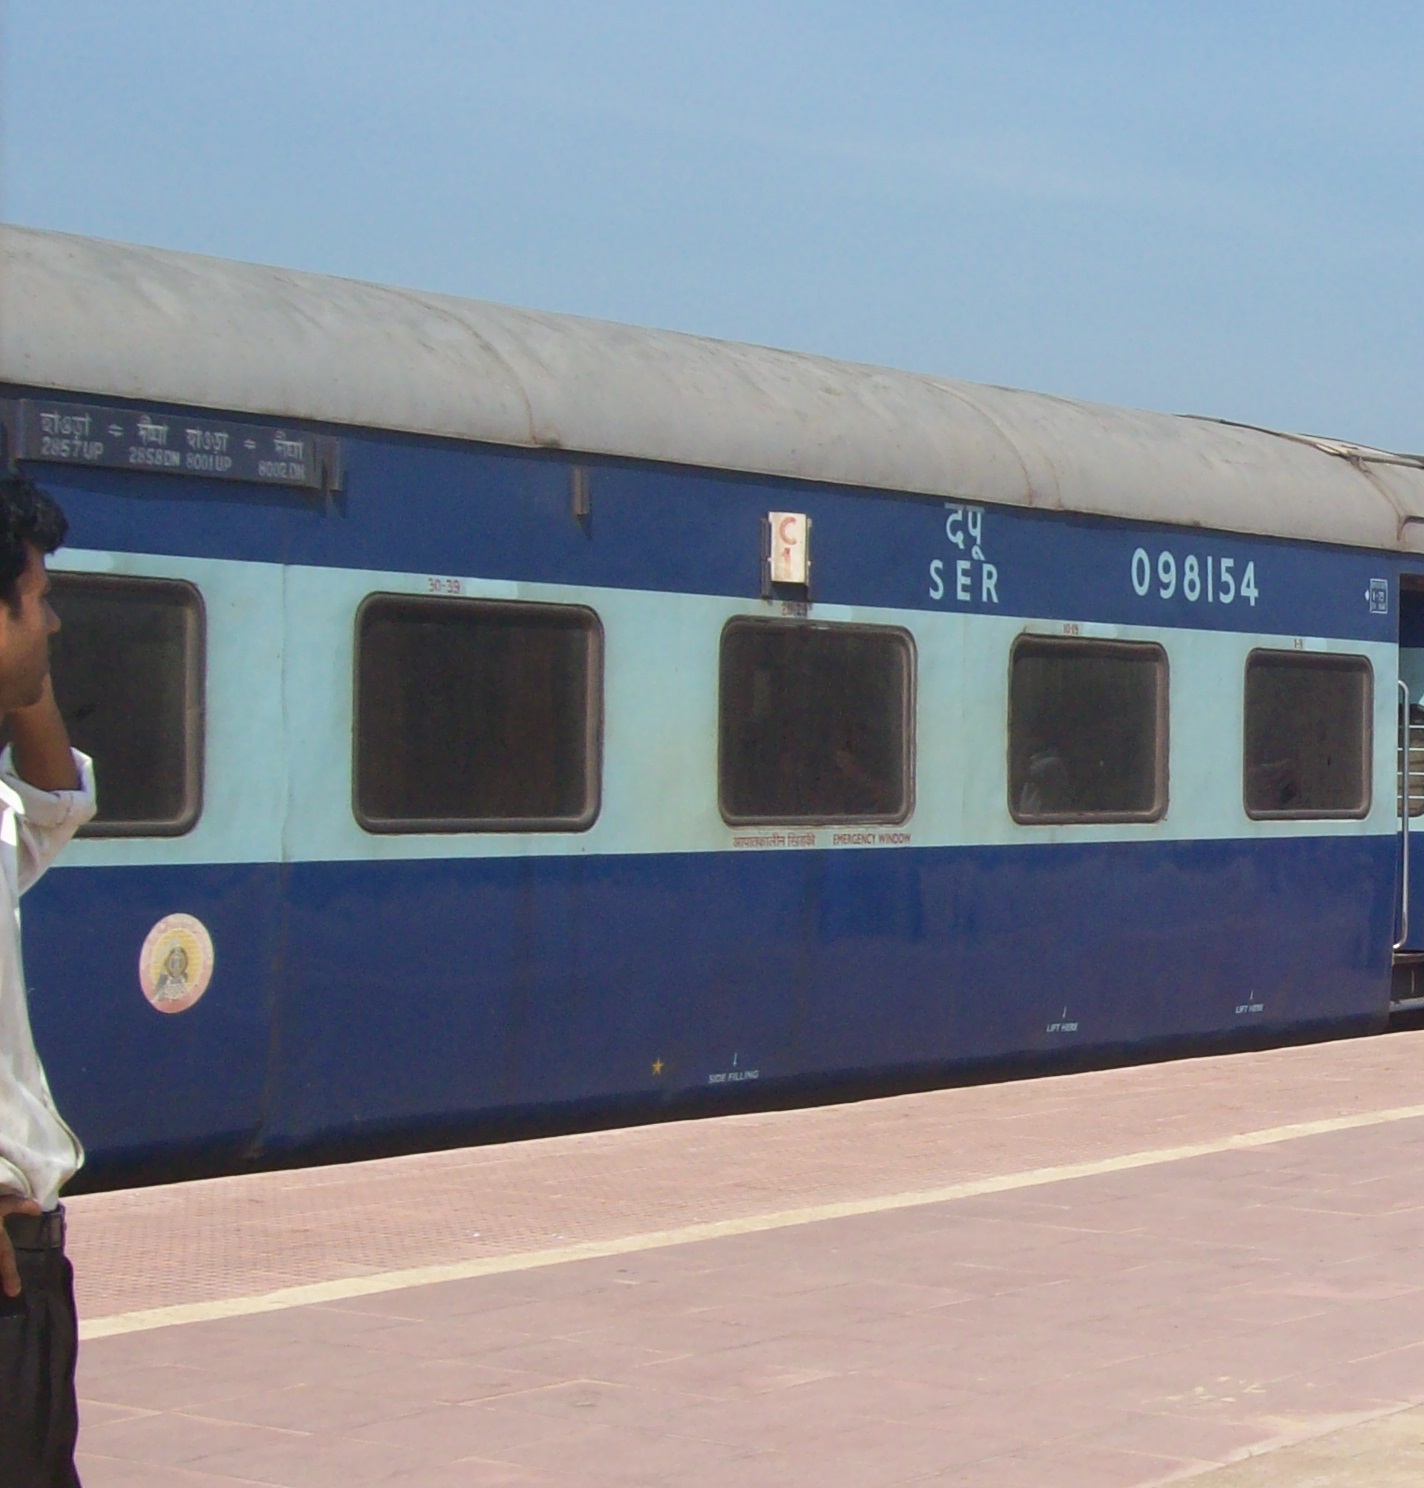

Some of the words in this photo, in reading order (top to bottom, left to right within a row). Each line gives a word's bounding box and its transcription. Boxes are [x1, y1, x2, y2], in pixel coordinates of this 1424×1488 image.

[779, 516, 798, 546] C
[929, 559, 999, 603] SER
[1131, 547, 1259, 607] 098154
[833, 833, 876, 845] EMERGENCY
[878, 833, 912, 845] WINDOW
